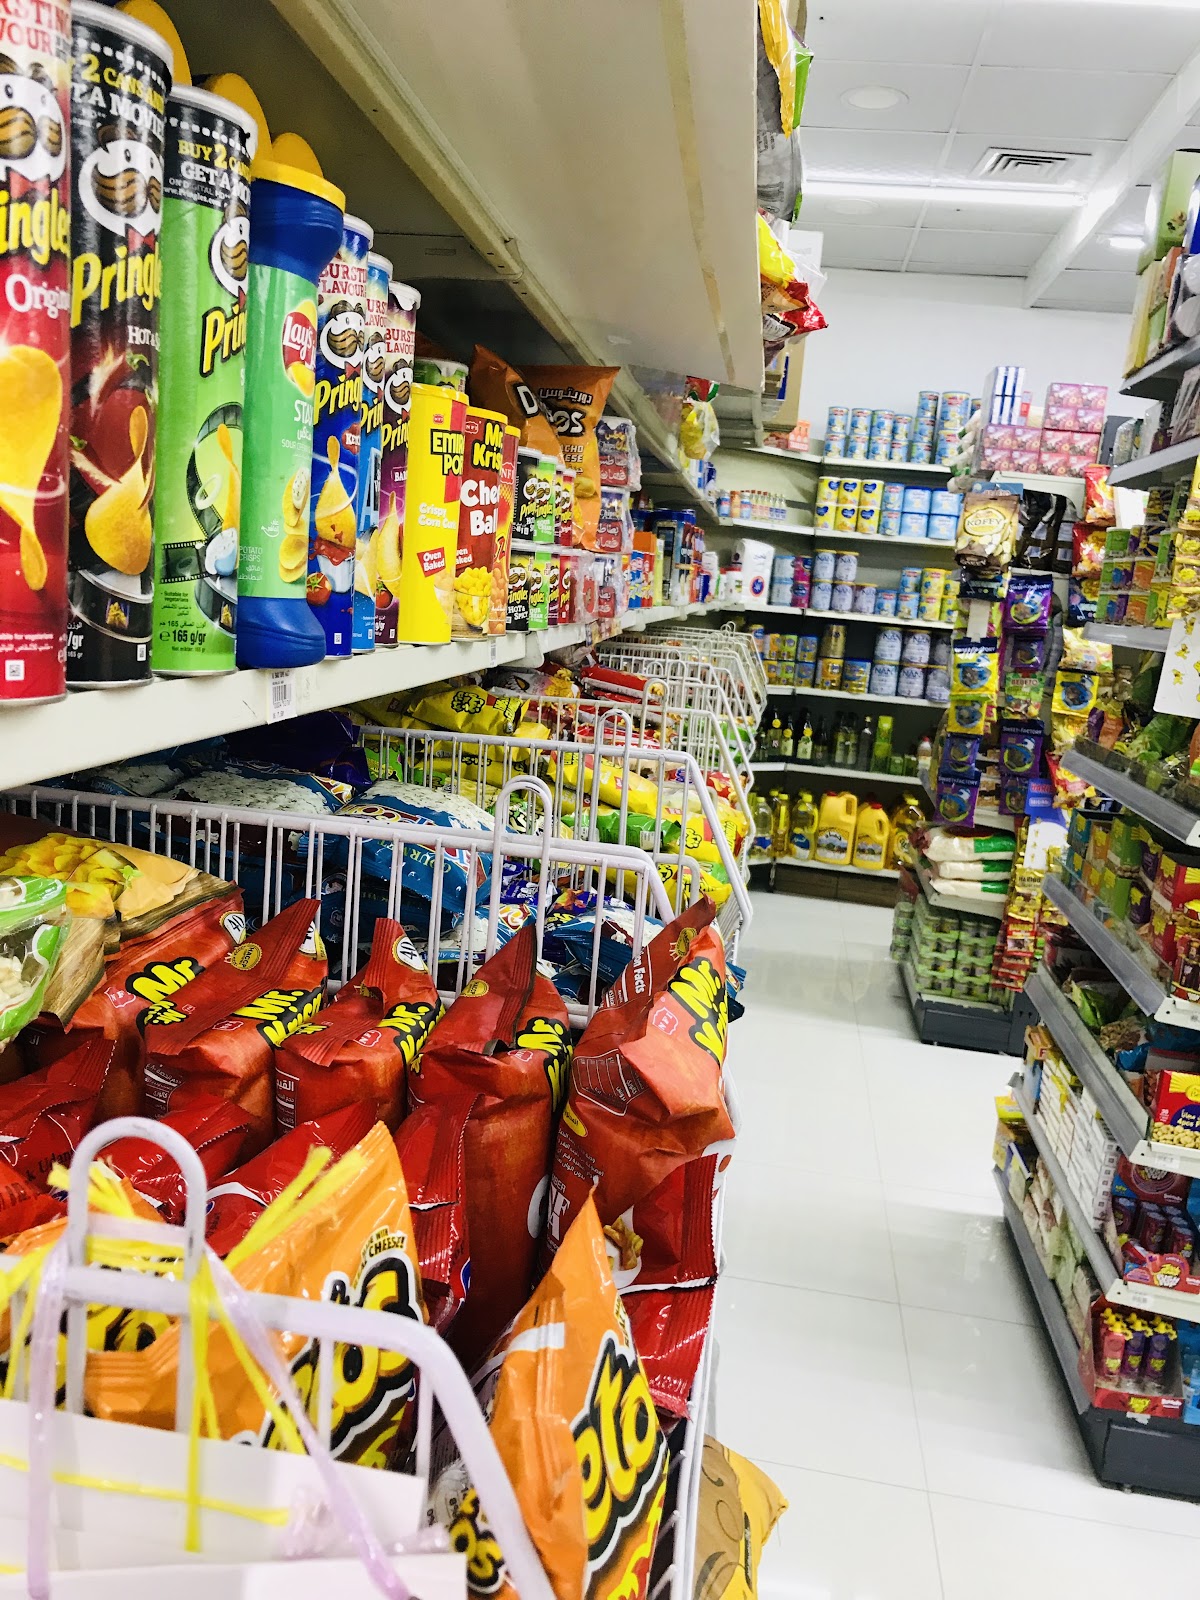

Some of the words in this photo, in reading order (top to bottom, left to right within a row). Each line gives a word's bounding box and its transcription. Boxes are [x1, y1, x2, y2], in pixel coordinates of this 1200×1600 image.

[177, 139, 213, 162] BUY
[214, 143, 228, 170] 2
[180, 161, 218, 187] GET
[219, 172, 231, 194] A
[283, 316, 315, 361] Lay's
[423, 550, 443, 562] Oven
[424, 558, 446, 572] Baked
[172, 629, 188, 642] 165
[190, 629, 207, 646] g/gr
[227, 914, 245, 933] 40
[399, 940, 418, 961] 40
[634, 967, 647, 994] Facts
[368, 1235, 405, 1258] CHEESE!
